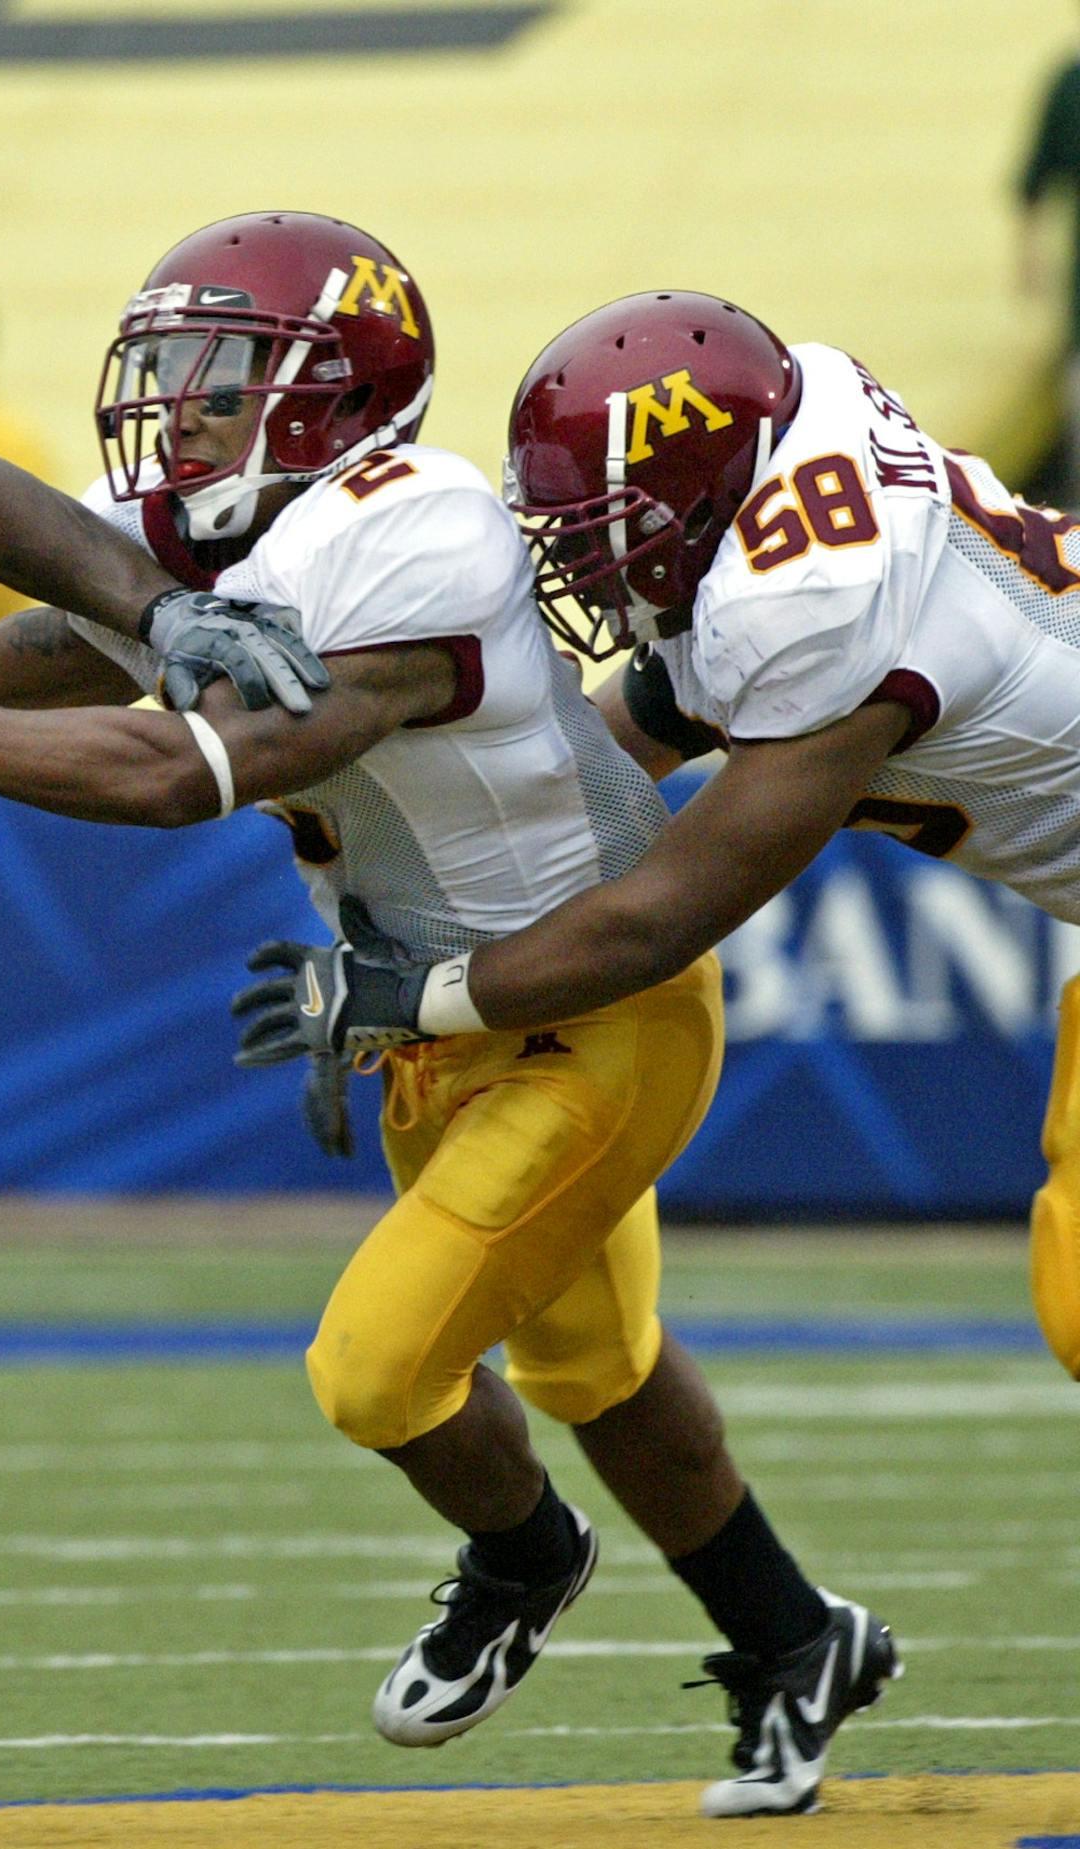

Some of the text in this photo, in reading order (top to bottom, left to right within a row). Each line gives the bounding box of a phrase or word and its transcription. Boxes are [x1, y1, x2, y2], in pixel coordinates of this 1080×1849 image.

[336, 255, 420, 339] M
[625, 368, 734, 465] M
[732, 450, 881, 576] 58
[718, 866, 1080, 1043] BAN
